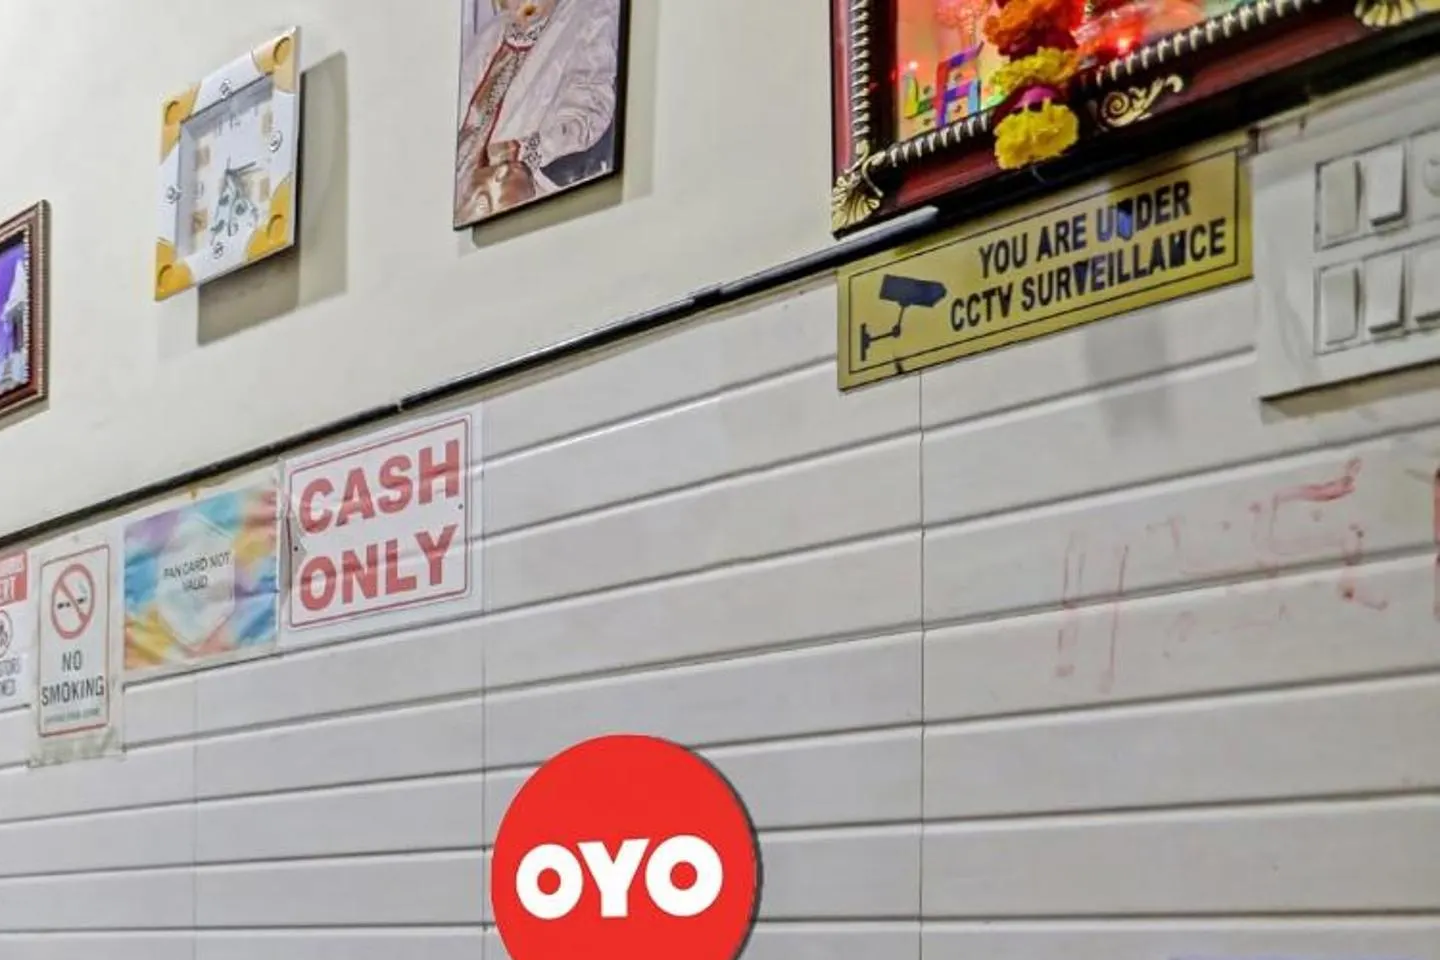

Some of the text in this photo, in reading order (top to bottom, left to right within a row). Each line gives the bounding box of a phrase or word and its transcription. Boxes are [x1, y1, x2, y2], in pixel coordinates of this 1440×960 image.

[979, 180, 1192, 279] YOU ARE UNDER
[950, 217, 1226, 332] CCTV SURVEILLANCE
[299, 439, 459, 534] CASH
[209, 551, 231, 568] NOT
[299, 524, 458, 611] ONLY
[41, 675, 105, 707] SMOKING
[62, 649, 82, 672] NO
[515, 834, 724, 920] OYO
